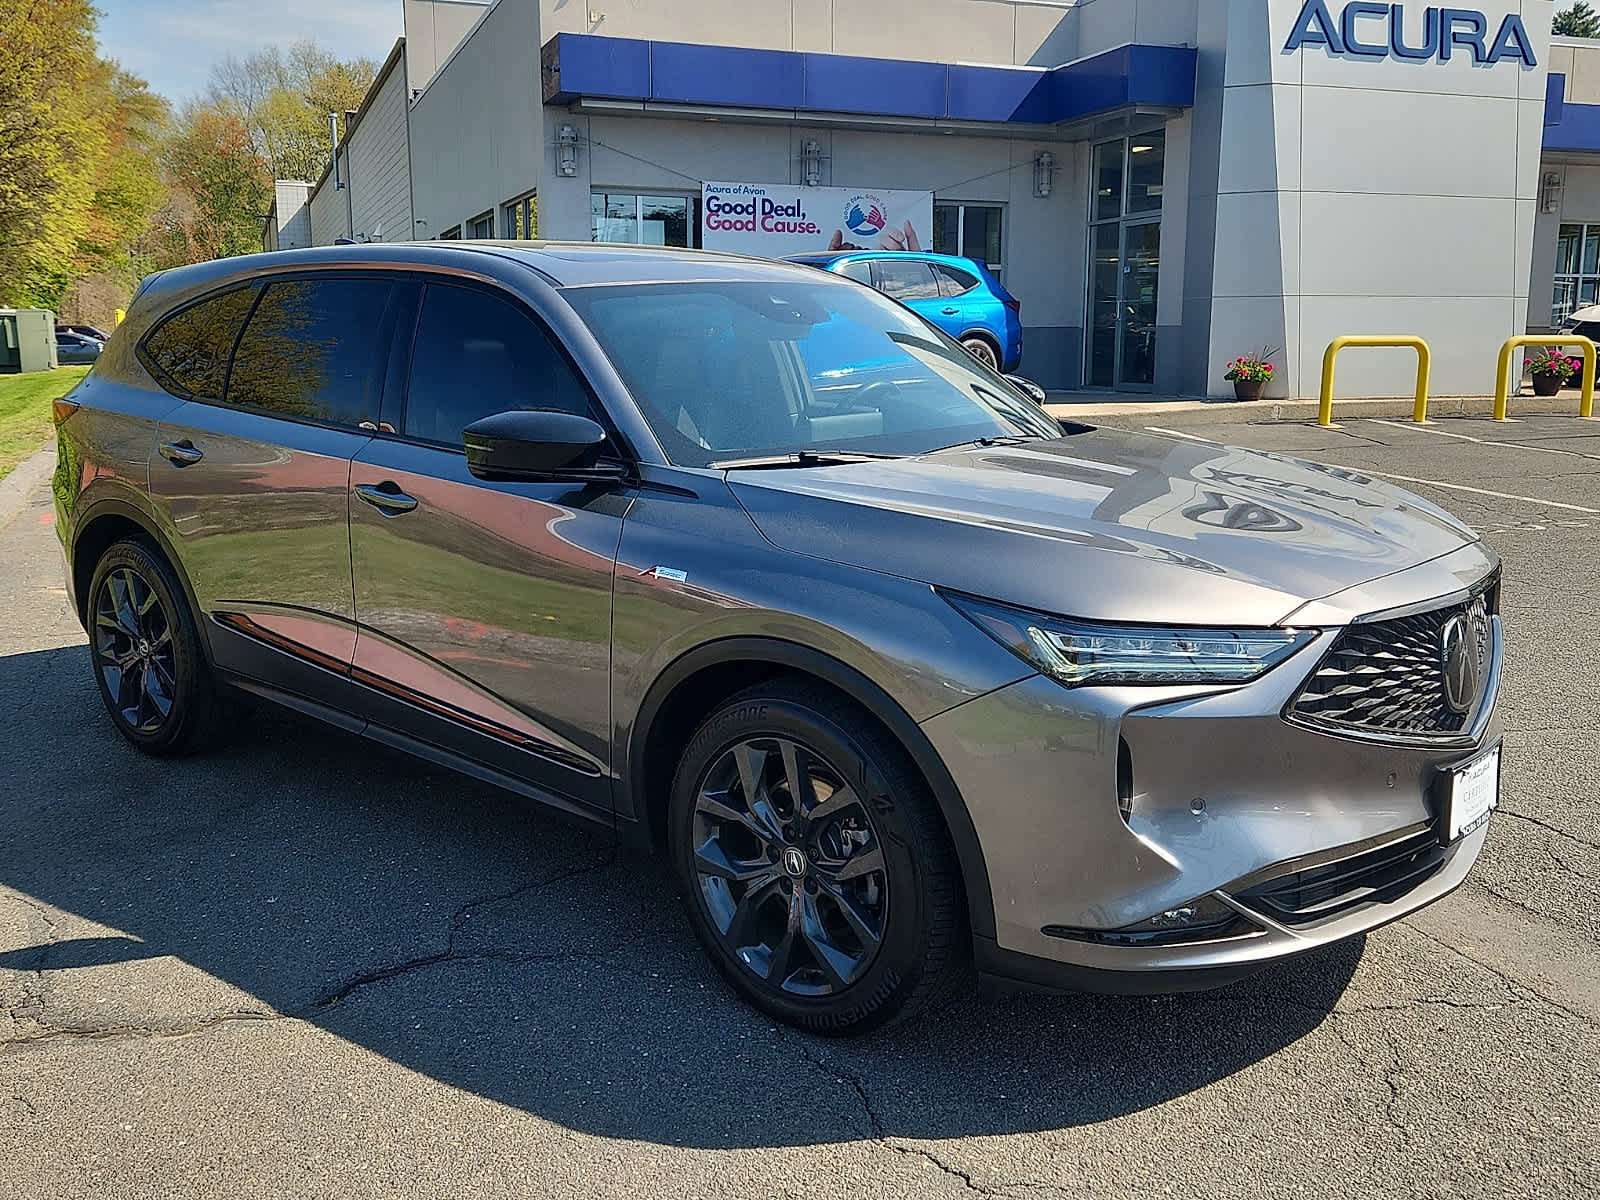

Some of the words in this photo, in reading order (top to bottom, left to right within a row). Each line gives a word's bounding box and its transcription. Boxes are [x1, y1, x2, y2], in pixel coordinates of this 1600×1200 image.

[1282, 0, 1538, 68] ACURA
[705, 183, 731, 194] Acura
[732, 184, 742, 194] of
[742, 185, 765, 196] Avon
[705, 195, 757, 215] Good
[761, 198, 807, 221] Deal,
[705, 212, 757, 232] Good
[760, 214, 822, 235] Cause.
